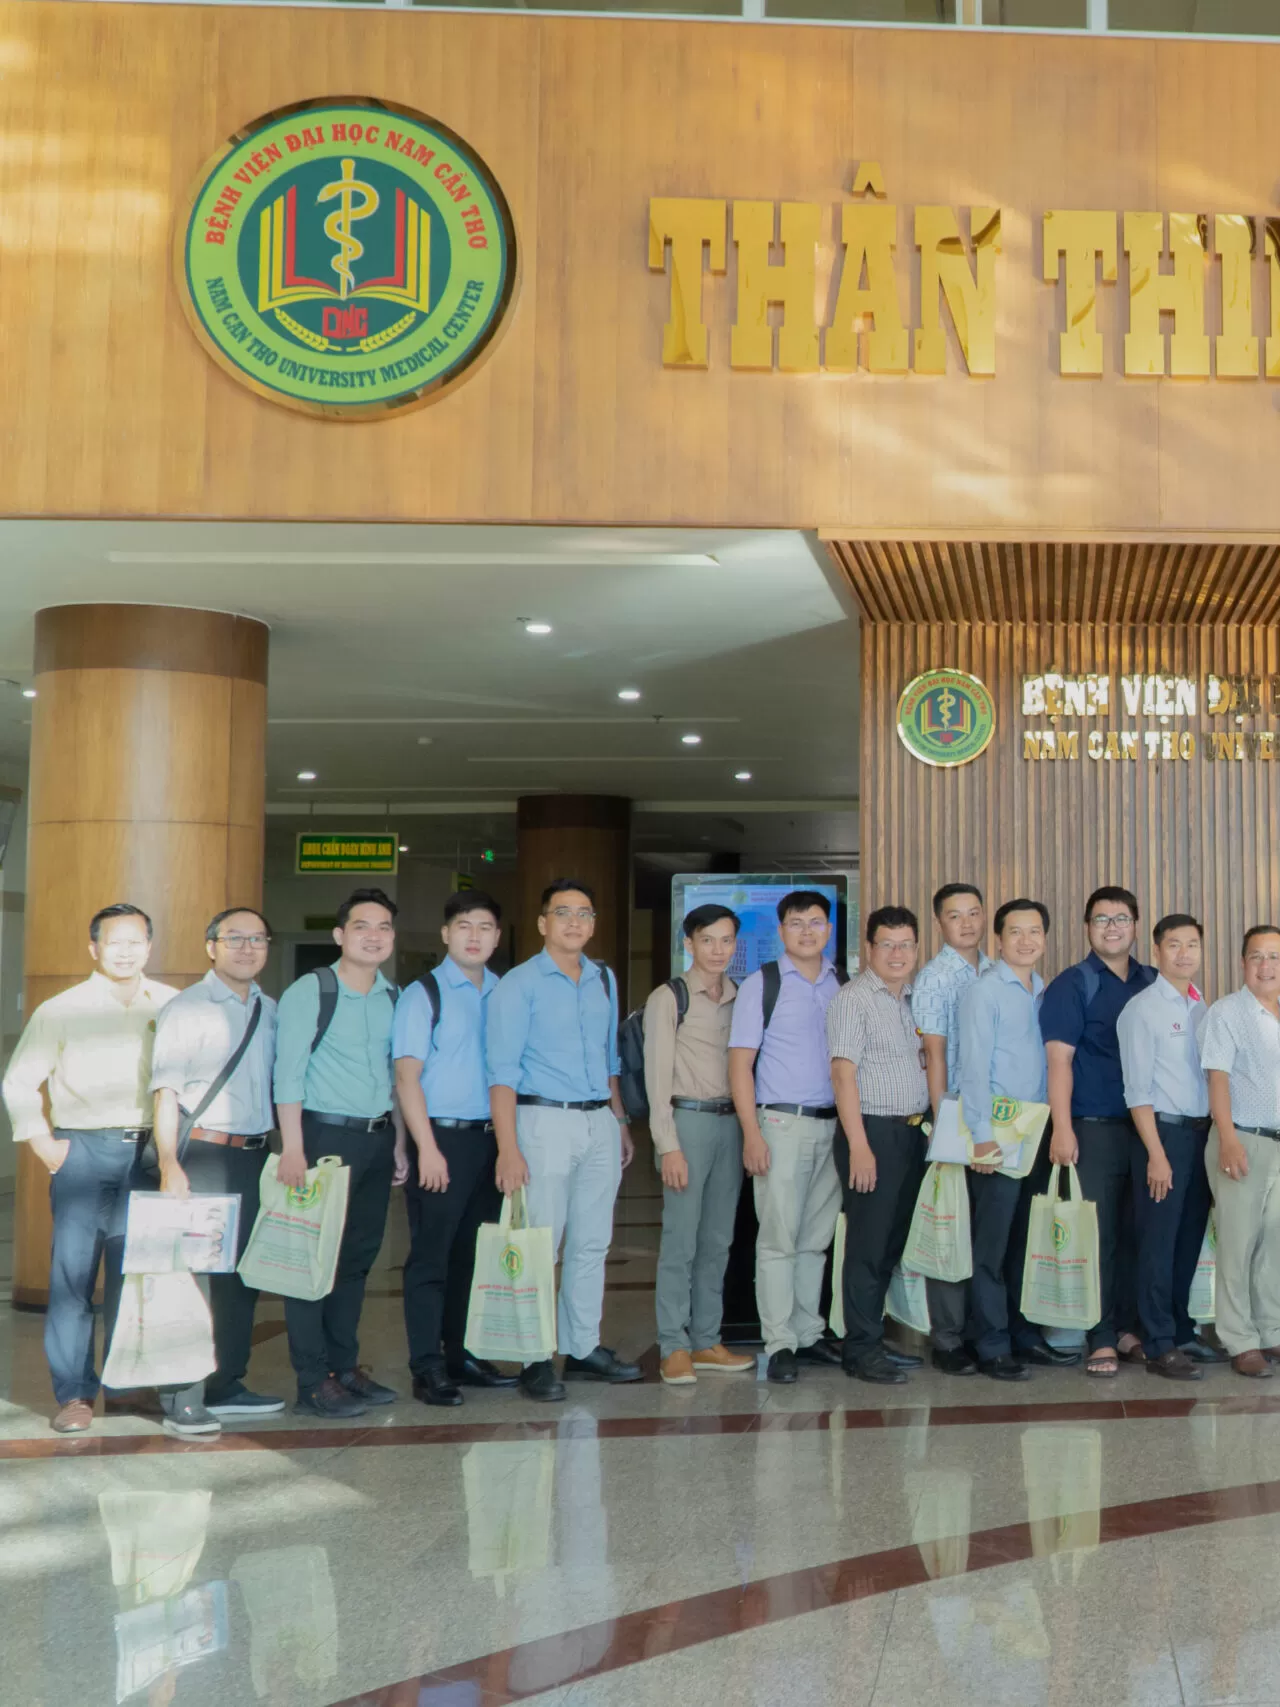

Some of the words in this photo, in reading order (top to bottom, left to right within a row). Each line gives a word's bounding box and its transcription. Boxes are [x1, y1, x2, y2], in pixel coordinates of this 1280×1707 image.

[205, 181, 243, 246] BỆNH
[234, 142, 284, 187] VIỆN
[284, 125, 325, 155] ĐẠI
[331, 123, 380, 148] HỌC
[383, 130, 437, 168] NAM
[460, 204, 489, 251] THƠ
[648, 161, 1001, 377] THÂN
[205, 276, 233, 312] NAM
[221, 308, 252, 346] CAN
[245, 335, 280, 367] THO
[278, 358, 377, 389] UNIVERSITY
[378, 336, 450, 383] MEDICAL
[443, 279, 485, 341] CENTER
[1022, 664, 1110, 725] BỆNH
[1121, 667, 1197, 725] VIỆN
[1023, 731, 1079, 760] NAM
[1088, 731, 1139, 760] CAN
[1144, 731, 1196, 760] THO
